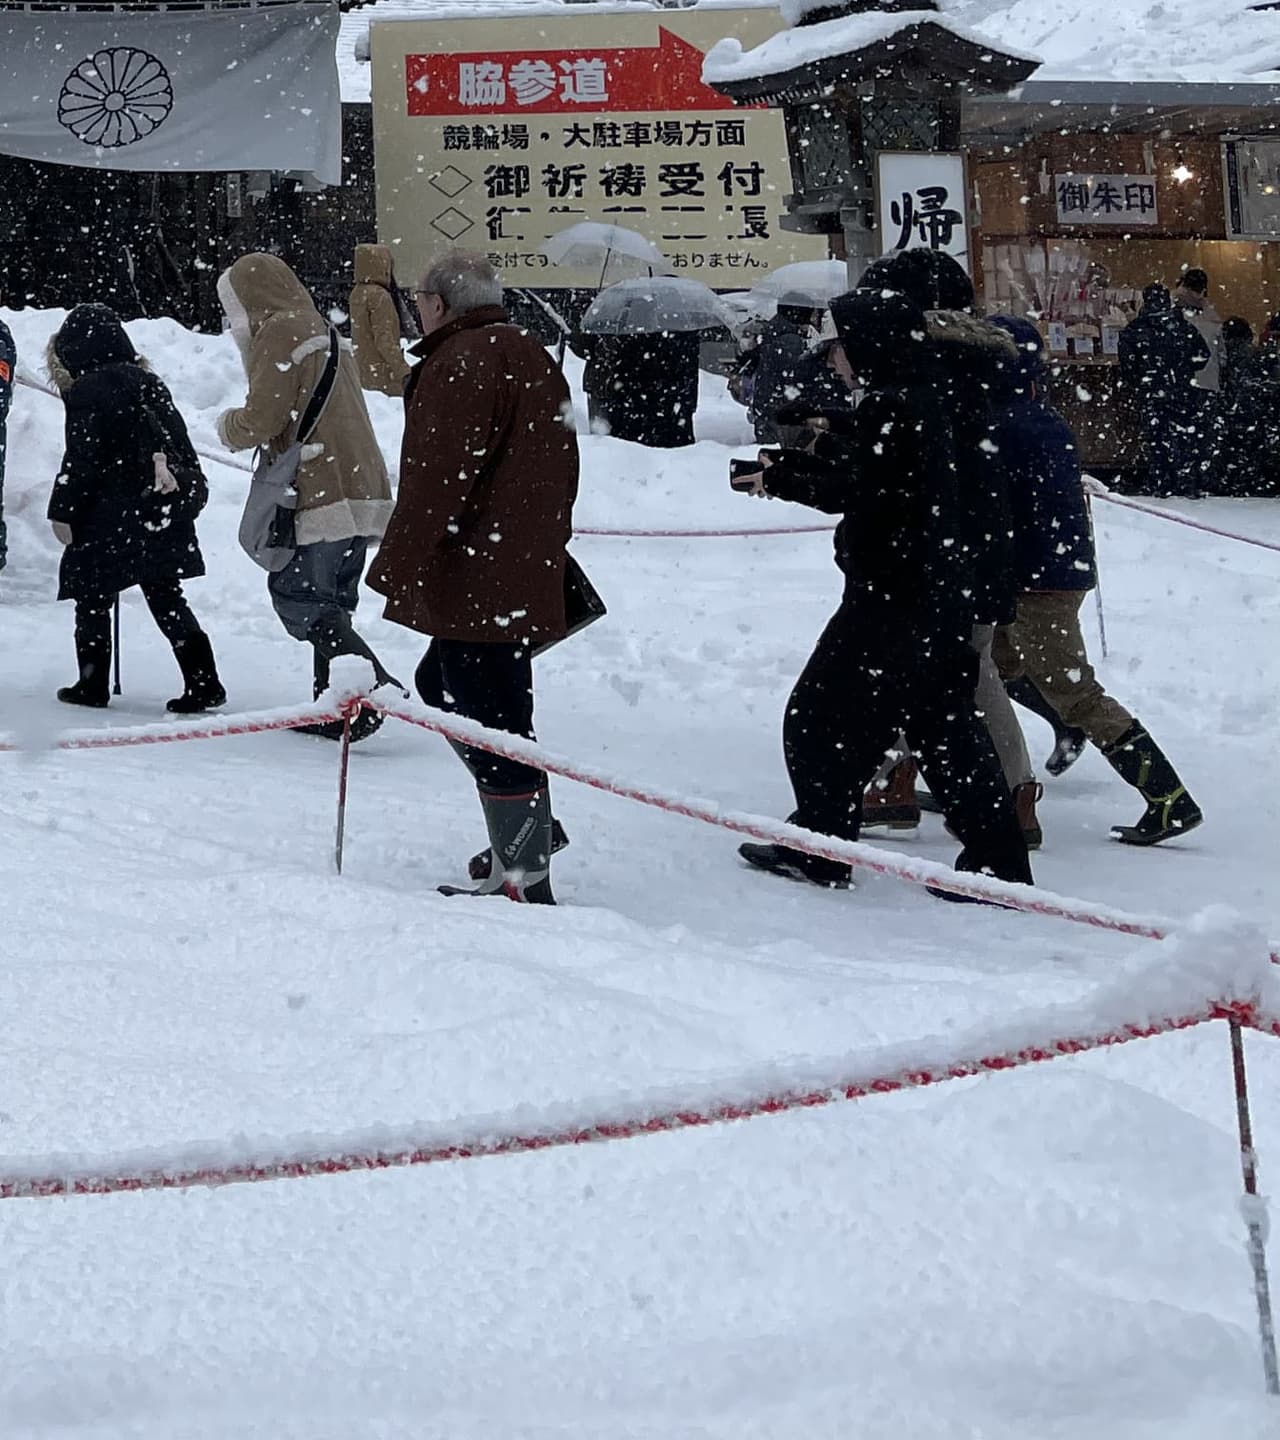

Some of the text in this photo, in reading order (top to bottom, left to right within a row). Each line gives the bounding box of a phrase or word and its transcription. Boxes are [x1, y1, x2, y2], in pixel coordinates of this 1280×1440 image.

[458, 58, 609, 107] 脇参道
[442, 119, 746, 152] 競輪場・大駐車場方面
[483, 161, 766, 200] 御祈祷受付
[1058, 181, 1155, 214] 御朱印
[891, 186, 963, 250] 帰
[662, 252, 769, 268] おりません。
